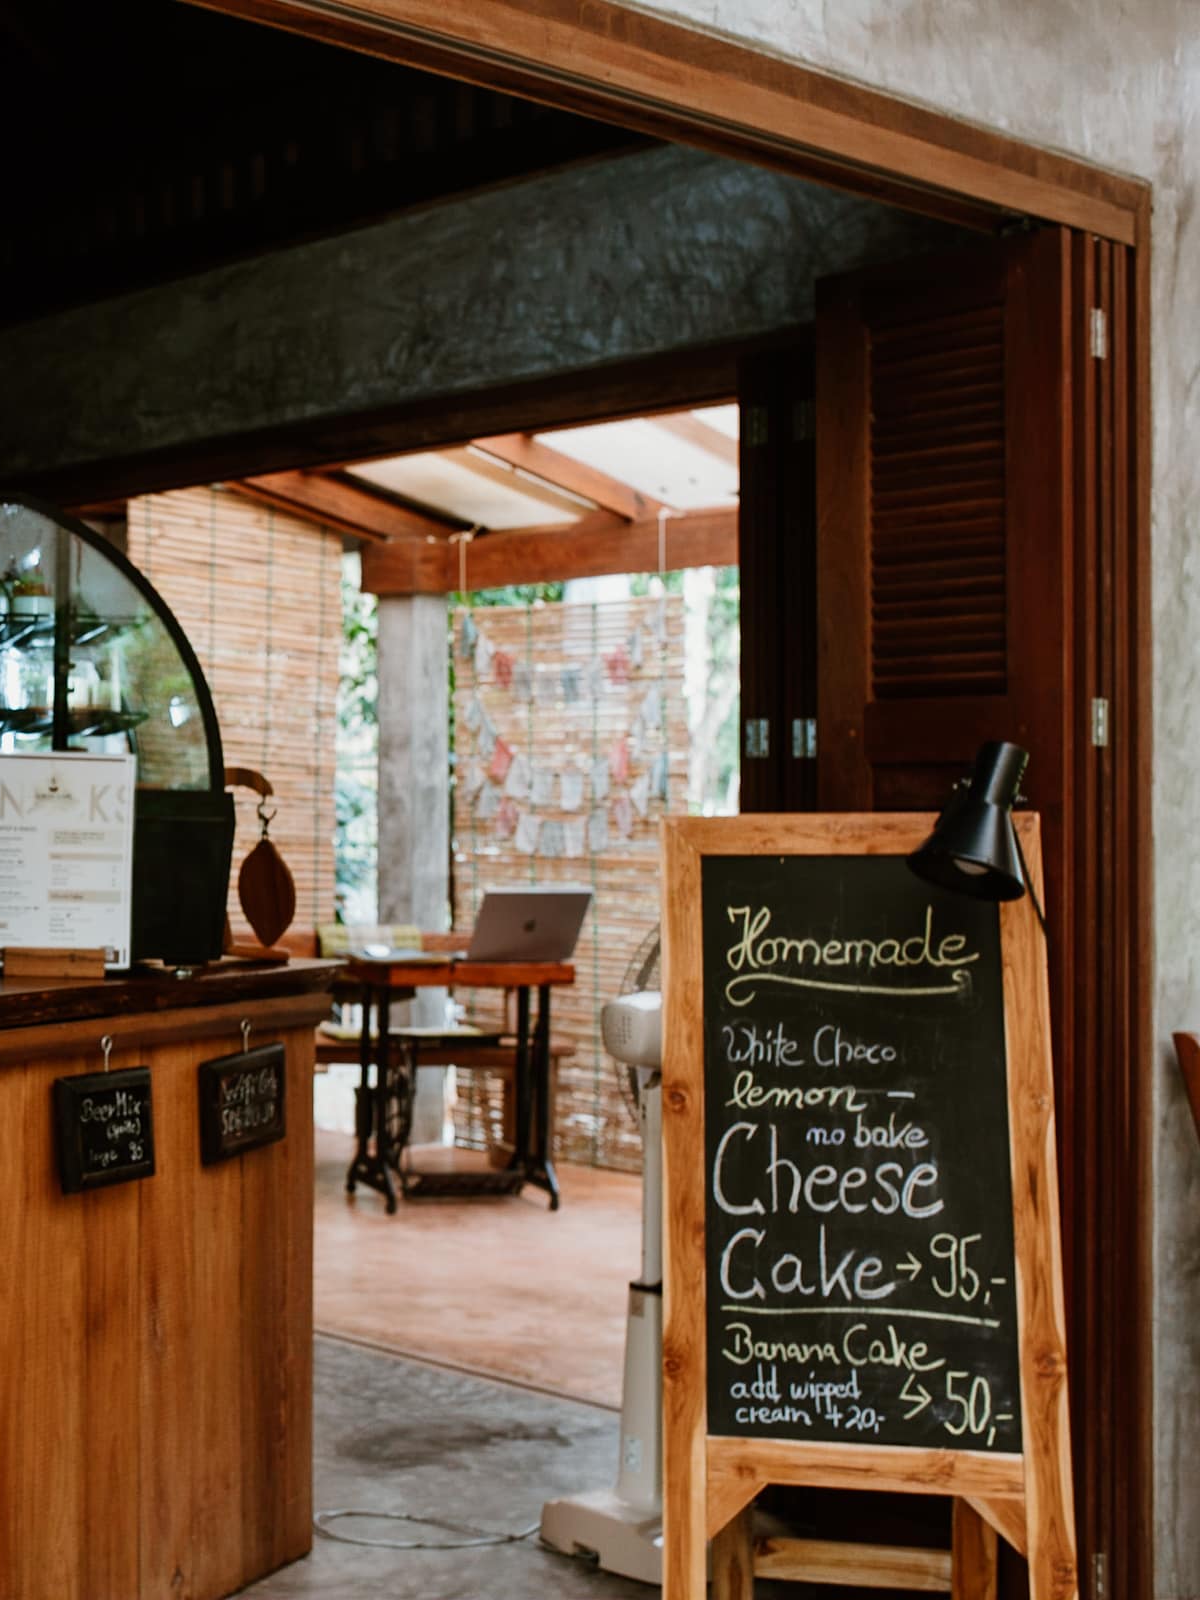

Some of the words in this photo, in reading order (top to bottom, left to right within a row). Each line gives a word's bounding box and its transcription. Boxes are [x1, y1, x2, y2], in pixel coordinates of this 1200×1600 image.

[726, 904, 980, 970] Homemade
[722, 1021, 804, 1067] White
[813, 1025, 897, 1067] Choco
[725, 1070, 867, 1112] lemon
[806, 1126, 845, 1145] no
[853, 1112, 929, 1148] bake
[713, 1122, 944, 1218] Cheese
[720, 1223, 897, 1300] Cake
[722, 1322, 841, 1365] Banana
[842, 1323, 946, 1371] Cake
[730, 1362, 782, 1404] add
[790, 1371, 862, 1414] wipped
[735, 1404, 812, 1426] cream
